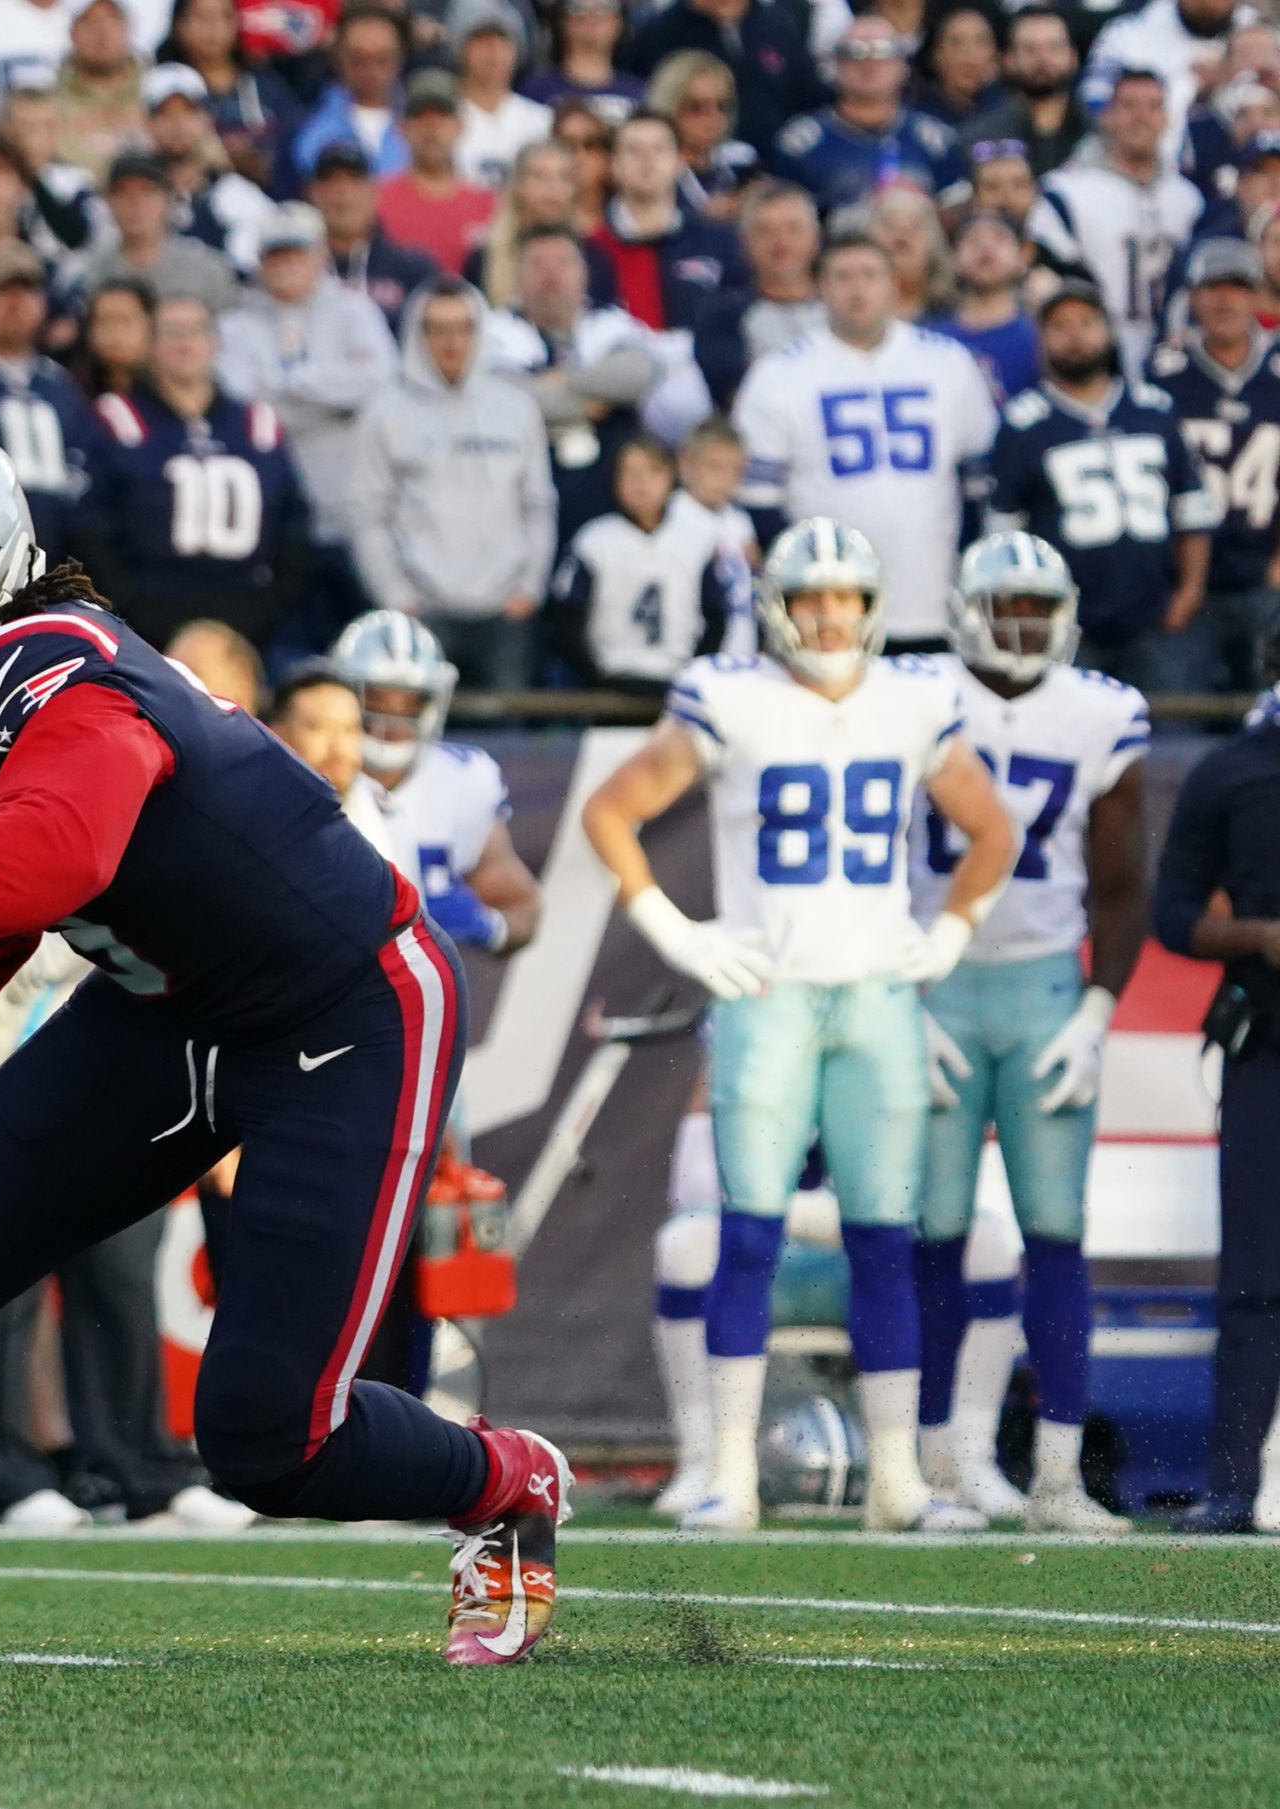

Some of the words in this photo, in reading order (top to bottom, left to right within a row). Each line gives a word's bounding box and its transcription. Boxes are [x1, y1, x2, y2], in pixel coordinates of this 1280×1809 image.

[819, 386, 932, 477] 55
[162, 453, 263, 560] 10
[1043, 433, 1170, 549] 55
[757, 760, 902, 885] 89
